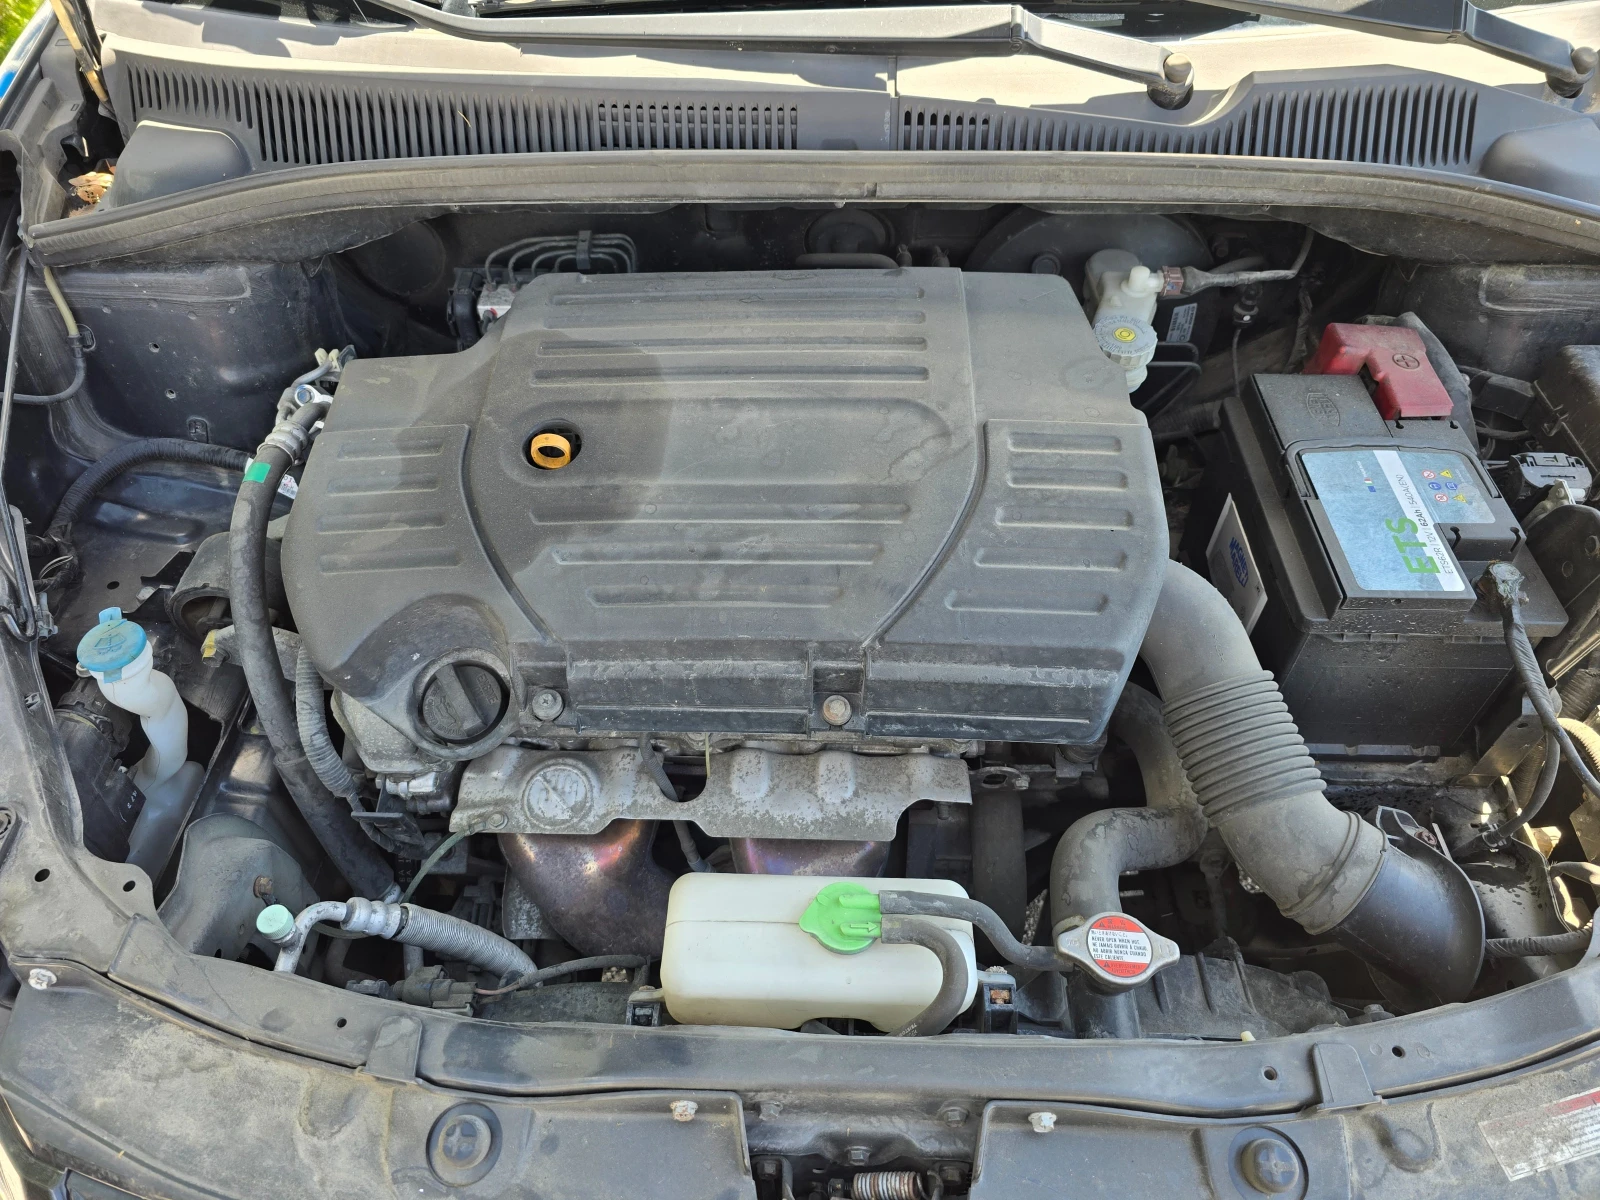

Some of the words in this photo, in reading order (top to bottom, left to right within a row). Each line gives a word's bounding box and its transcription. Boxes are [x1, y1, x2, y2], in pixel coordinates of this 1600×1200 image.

[1395, 474, 1418, 505] 540A(EN)
[1414, 509, 1428, 527] 62Ah
[1385, 517, 1440, 573] ETS
[1425, 530, 1436, 543] 12V
[1433, 547, 1453, 574] ETS62R
[477, 673, 499, 705] ENGINE
